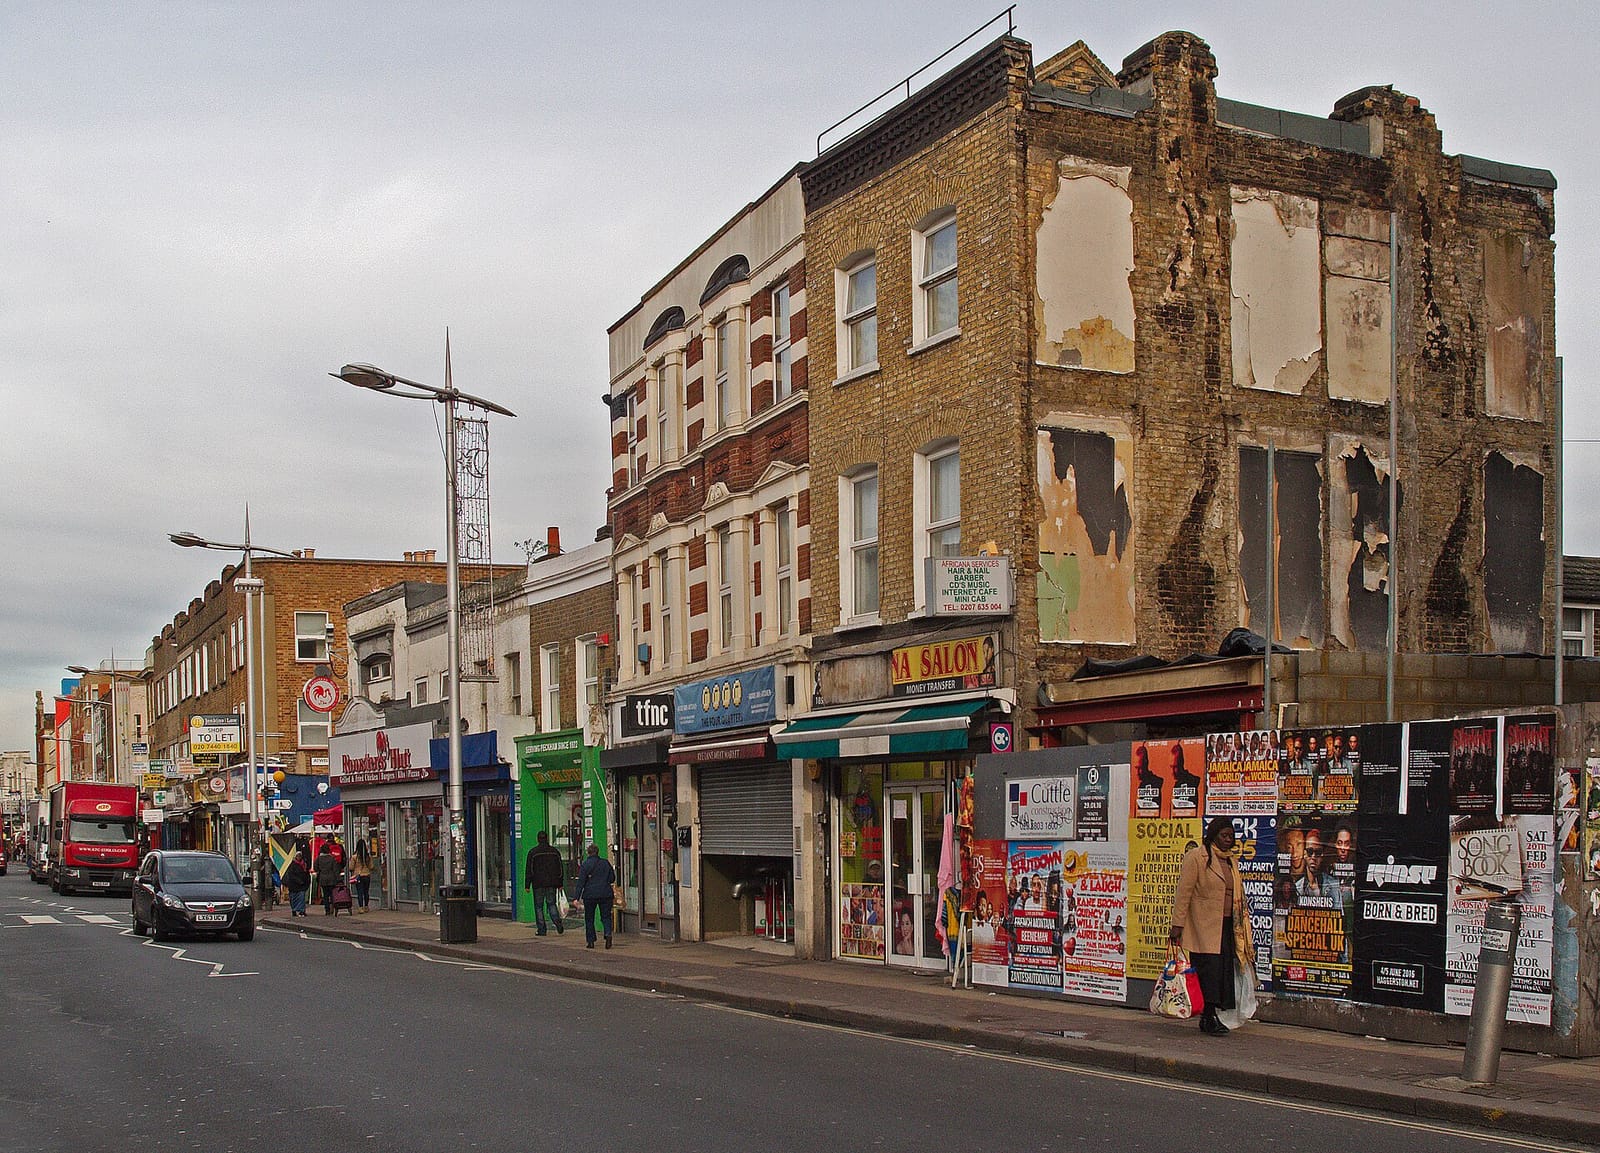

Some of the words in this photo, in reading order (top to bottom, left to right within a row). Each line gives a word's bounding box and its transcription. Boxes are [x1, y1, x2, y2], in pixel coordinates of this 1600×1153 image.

[971, 560, 1000, 568] SERVICES
[921, 639, 979, 677] SALON
[906, 683, 926, 694] MONEY
[927, 680, 956, 692] TRANSFER
[636, 699, 669, 726] tfnc
[701, 717, 710, 727] THE
[710, 715, 721, 727] FOUR
[721, 713, 743, 725] QUARTERS
[197, 733, 212, 742] TO
[215, 733, 234, 742] LET
[389, 748, 412, 769] Hut
[1208, 761, 1242, 772] JAMAICA
[1242, 760, 1278, 772] JAMAICA
[365, 773, 379, 781] Chicken
[1216, 772, 1240, 782] WORLD
[1250, 771, 1275, 781] WORLD
[1031, 781, 1071, 804] Cuttle
[1136, 823, 1194, 839] SOCIAL
[1526, 830, 1548, 843] SAT
[1457, 834, 1512, 860] SONG
[1526, 842, 1547, 850] 20TH
[1143, 853, 1161, 862] ADAM
[1526, 851, 1548, 862] FEB
[1011, 851, 1062, 876] SHUTDOWN
[1134, 864, 1147, 872] ART
[1149, 864, 1183, 873] DEPARTM
[1252, 862, 1275, 871] PARTY
[1461, 854, 1510, 878] BOOK
[1527, 861, 1546, 869] 2016
[1134, 874, 1150, 883] EATS
[1152, 874, 1180, 883] EVERYTH
[1261, 872, 1275, 881] 2016
[1081, 879, 1088, 891] &
[1090, 880, 1122, 892] LAUGH
[1142, 884, 1155, 893] GUY
[1157, 885, 1178, 894] GERB
[1076, 897, 1096, 907] KANE
[1097, 898, 1125, 909] BROWN
[1141, 895, 1160, 904] JORIS
[1162, 895, 1176, 904] VOO
[1299, 896, 1334, 908] KONSHENS
[1076, 908, 1104, 919] QUINCY
[1134, 904, 1151, 914] MAYA
[1152, 905, 1168, 914] JANE
[1364, 902, 1392, 918] BORN
[1395, 904, 1402, 920] &
[1406, 904, 1436, 922] BRED
[1014, 917, 1034, 928] FRENCH
[1034, 918, 1055, 930] MONTANA
[1076, 919, 1093, 929] WILL
[1138, 915, 1150, 924] NIC
[1287, 915, 1344, 934] DANCEHALL
[1142, 925, 1157, 934] NINA
[1159, 926, 1171, 935] KRA
[1455, 925, 1484, 934] PETER
[1519, 929, 1543, 938] GALE
[1021, 930, 1048, 942] BEENIEMAN
[1098, 931, 1121, 942] STYLA
[1145, 936, 1163, 945] MANY
[1462, 934, 1481, 943] TOY
[1518, 939, 1536, 948] ALE
[1286, 932, 1328, 950] SPECIAL
[1330, 934, 1344, 952] UK
[1389, 967, 1402, 977] JUNE
[1448, 960, 1479, 970] PRIVAT
[1513, 966, 1550, 977] ECTION
[1010, 970, 1061, 986] ZANTESHUTDOWN.COM
